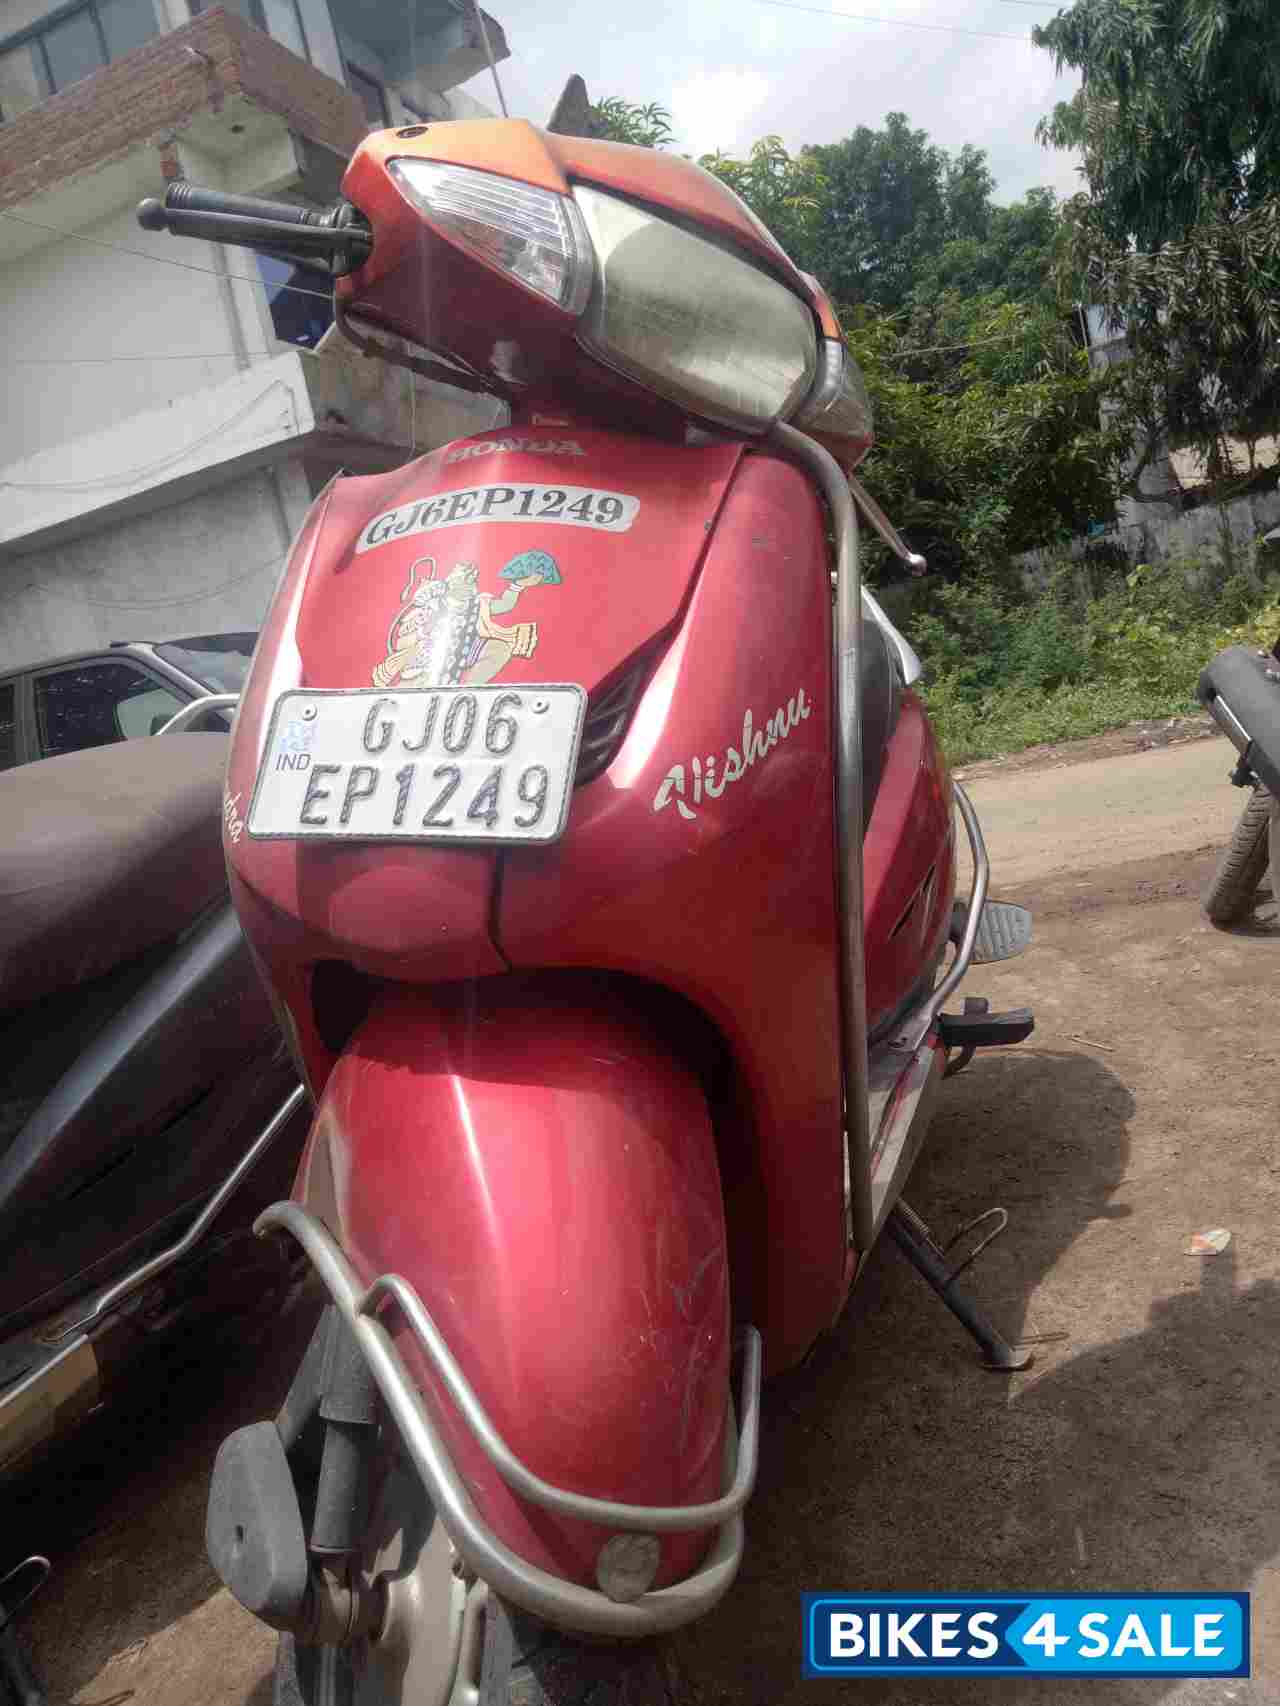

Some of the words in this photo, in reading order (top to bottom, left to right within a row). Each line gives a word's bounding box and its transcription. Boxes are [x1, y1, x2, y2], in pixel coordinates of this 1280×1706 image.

[366, 487, 624, 545] GJ6EP1249
[363, 692, 522, 753] GJ06
[275, 753, 311, 771] IND
[300, 763, 548, 828] EP1249
